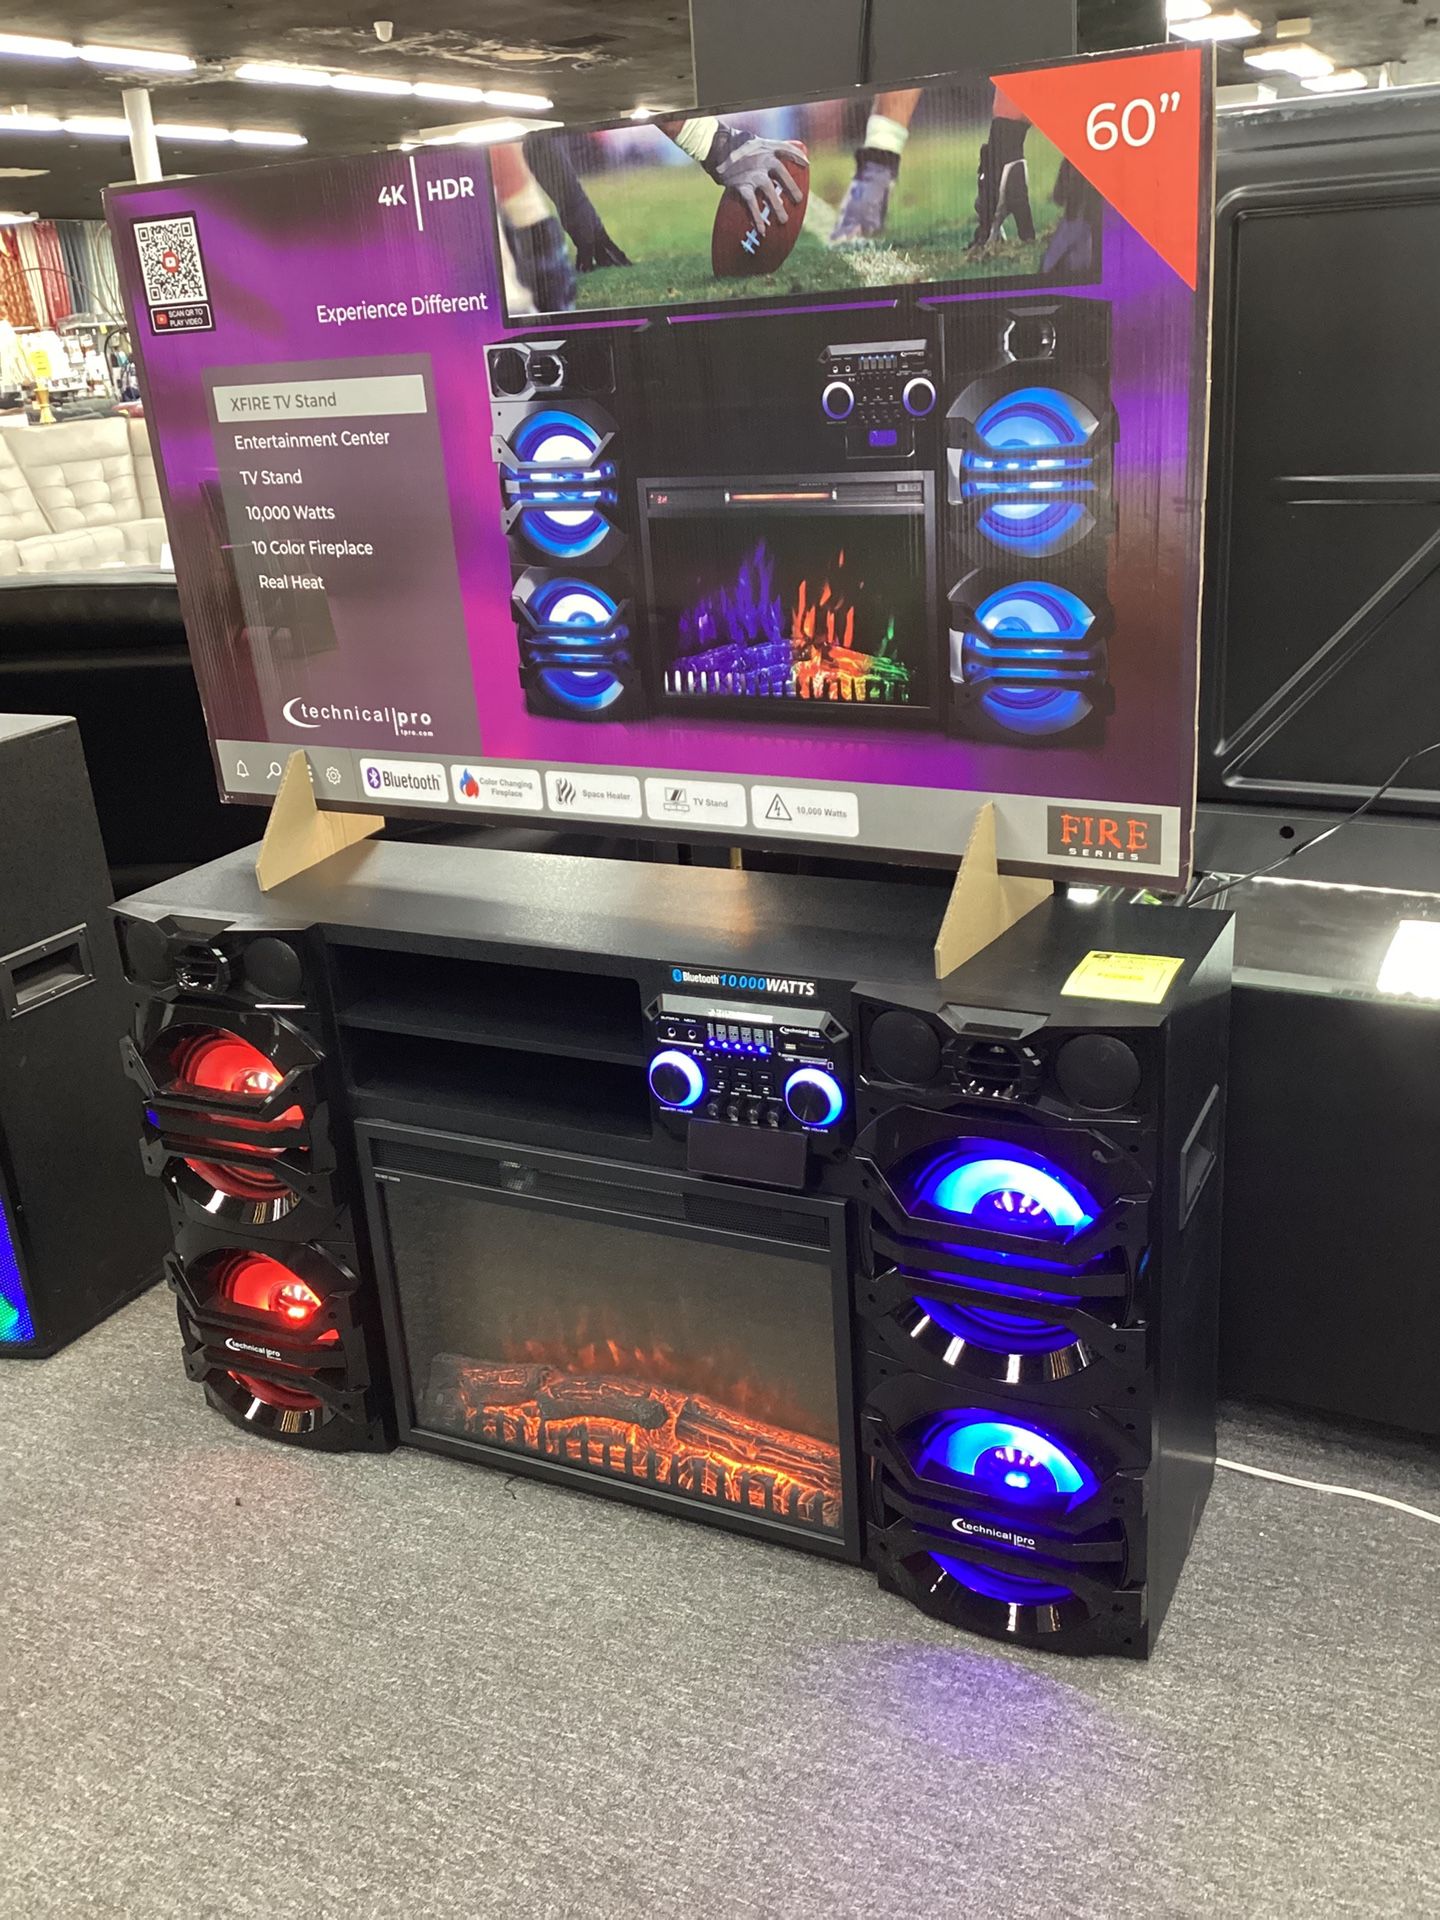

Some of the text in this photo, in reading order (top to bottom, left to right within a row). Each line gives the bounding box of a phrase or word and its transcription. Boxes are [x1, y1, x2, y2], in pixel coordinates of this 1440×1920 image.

[377, 176, 475, 207] 4K HDR
[168, 310, 185, 318] SCAN
[194, 308, 203, 316] TO
[317, 292, 488, 326] Experience Different
[169, 317, 203, 327] PLAY VIDEO
[230, 392, 337, 412] XFIRE TV Stand
[234, 429, 391, 450] Entertainment Center
[239, 468, 303, 486] TV Stand
[245, 504, 336, 523] 10,000 Watts
[252, 539, 374, 558] 10 Color Fireplace
[259, 574, 325, 590] Real Heat
[300, 702, 433, 727] technical pro
[382, 769, 442, 791] Bluetooth
[479, 777, 533, 790] Color Changing
[491, 788, 523, 798] Fireplace
[582, 789, 631, 801] Space Heater
[693, 797, 729, 808] TV Stand
[796, 805, 848, 819] 10,000 Watts
[1061, 813, 1149, 850] FIRE
[1068, 848, 1139, 861] SERIES
[682, 971, 720, 985] Bluetooth
[766, 978, 815, 997] WATTS
[232, 1341, 265, 1354] technical
[961, 1521, 1035, 1546] technical pro
